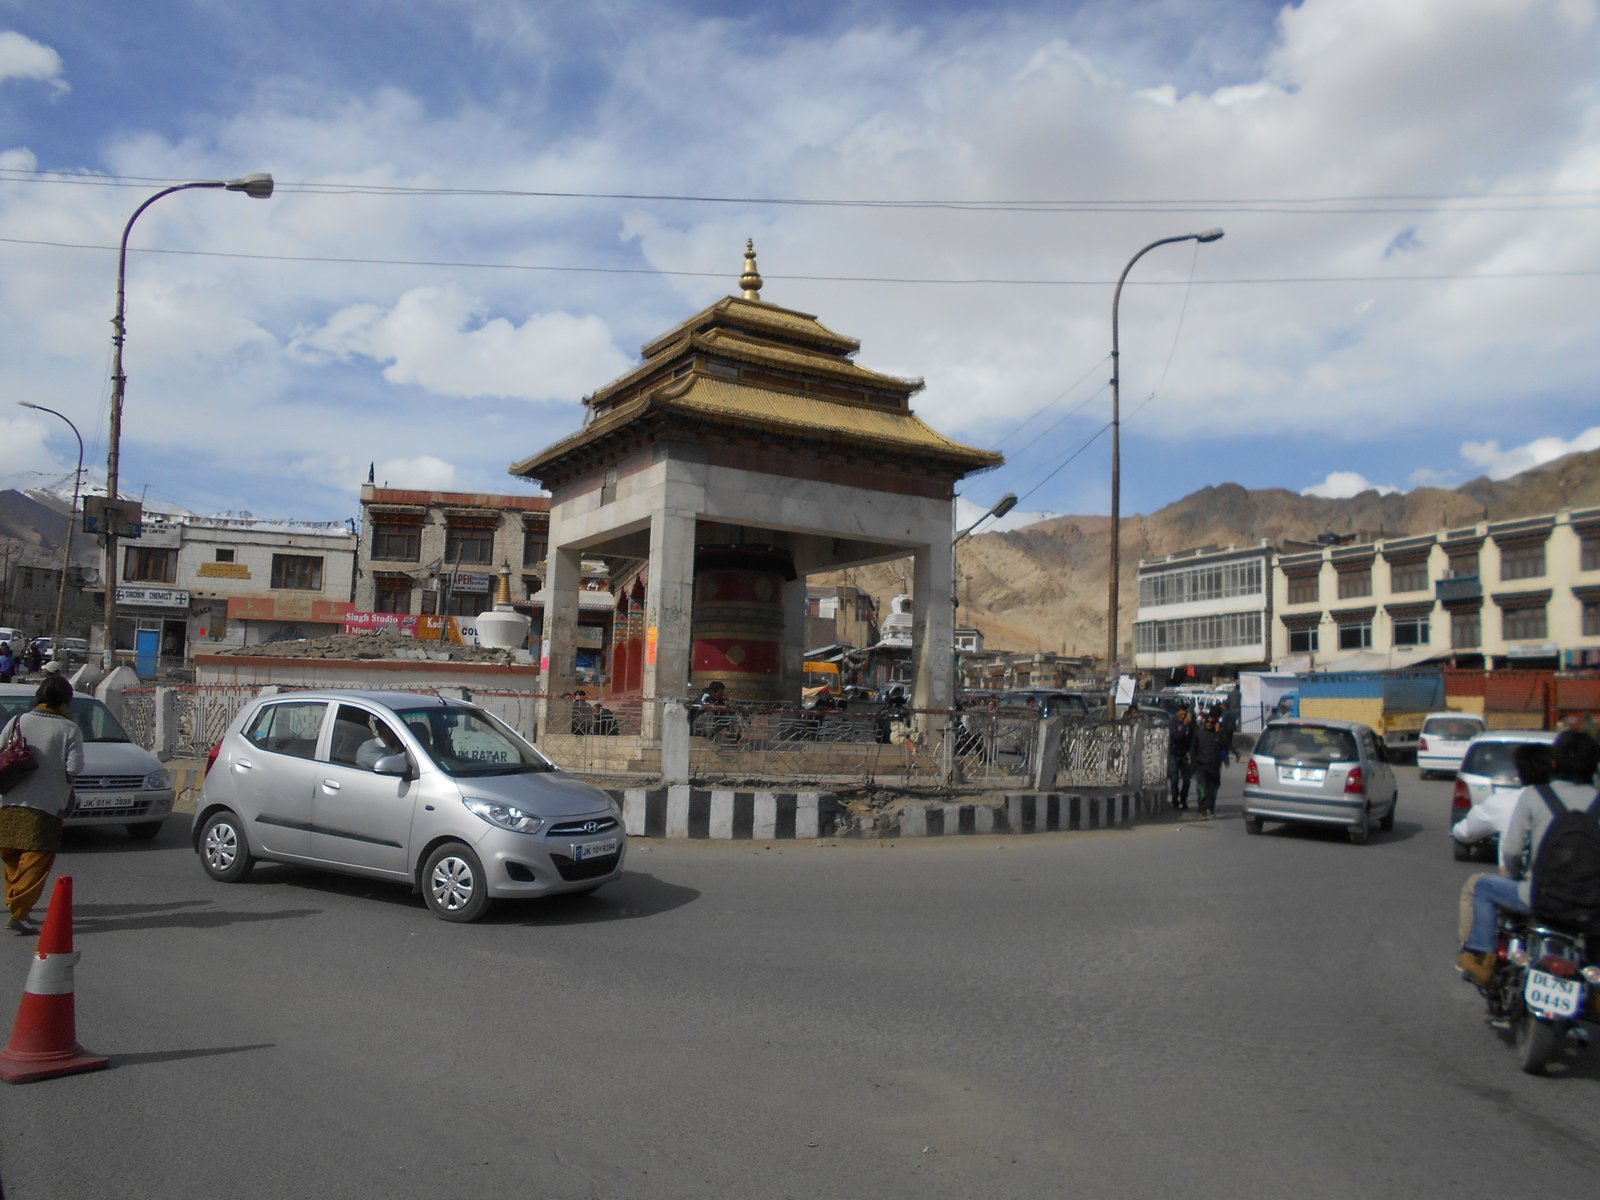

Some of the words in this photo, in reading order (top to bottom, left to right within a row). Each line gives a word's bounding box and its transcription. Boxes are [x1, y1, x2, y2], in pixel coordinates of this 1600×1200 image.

[149, 592, 172, 600] CHEMIST
[345, 612, 369, 623] Singh
[371, 614, 398, 623] Studio
